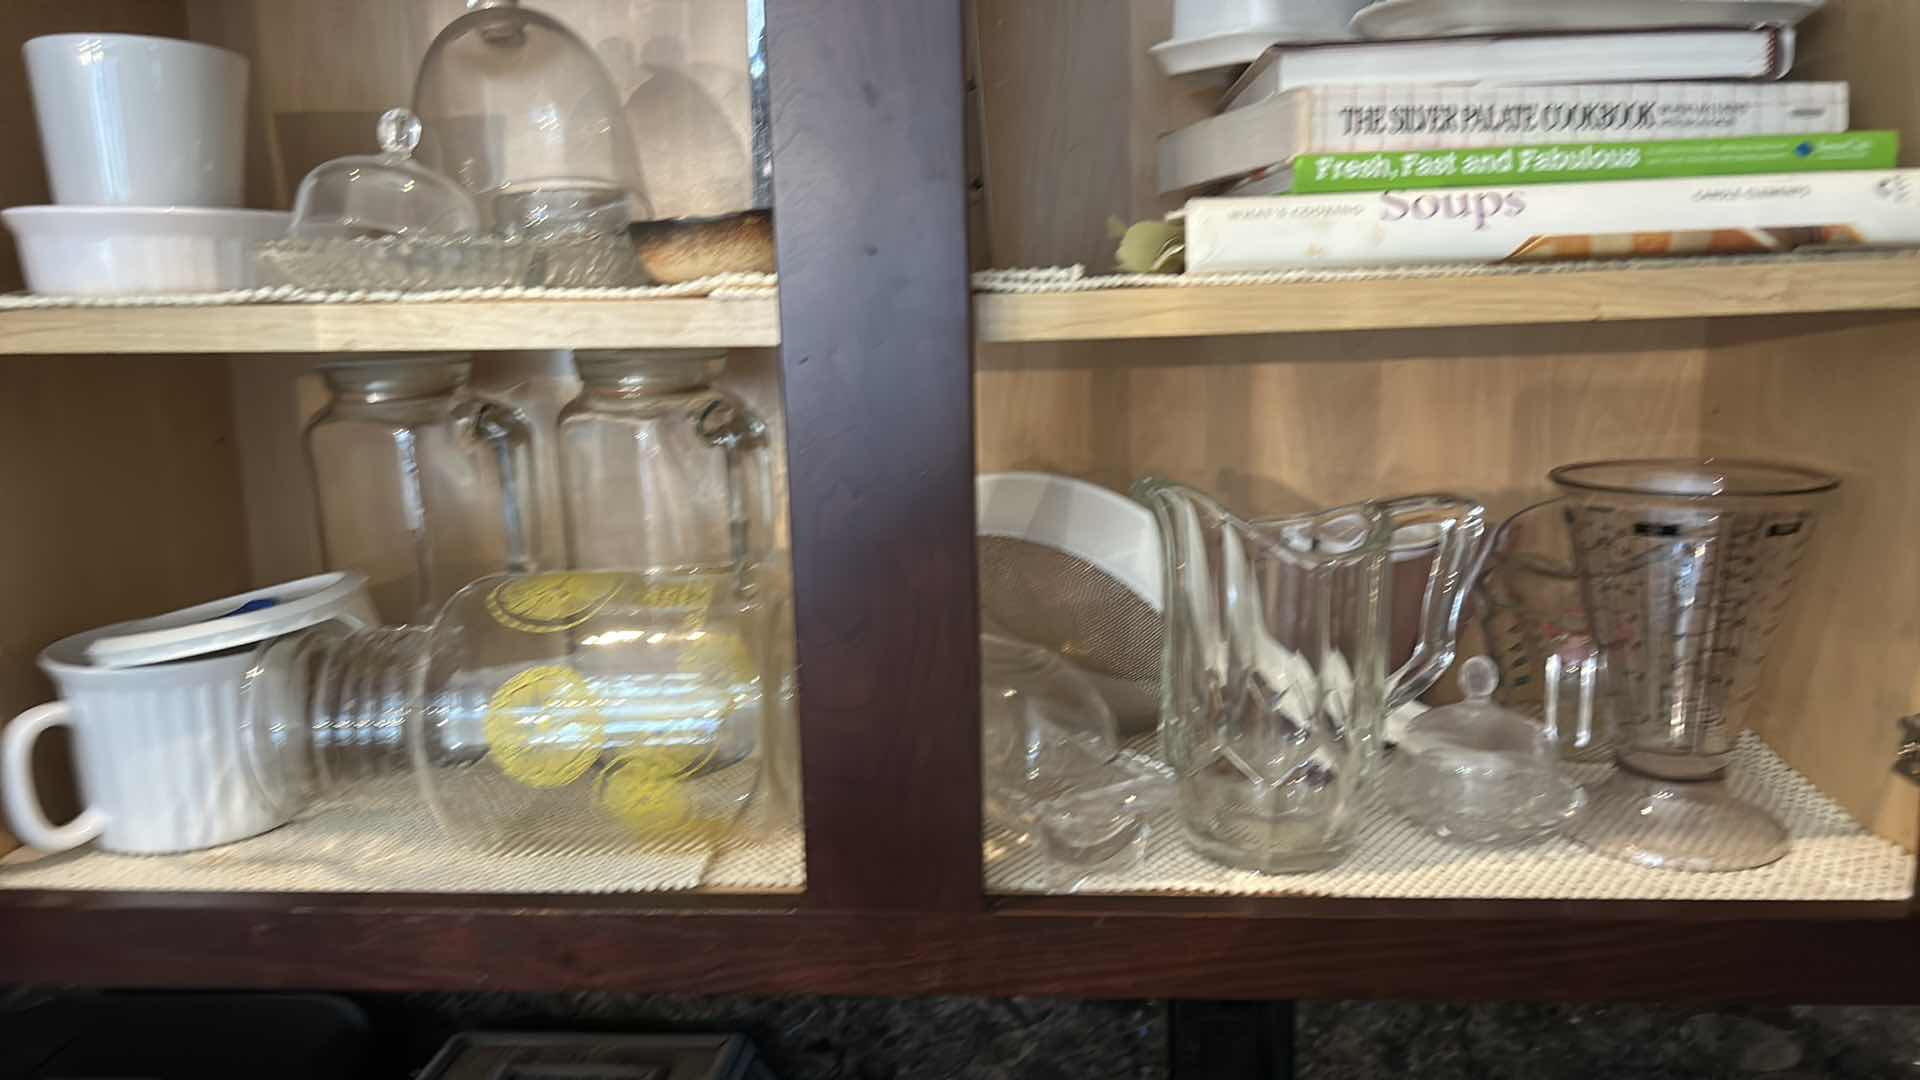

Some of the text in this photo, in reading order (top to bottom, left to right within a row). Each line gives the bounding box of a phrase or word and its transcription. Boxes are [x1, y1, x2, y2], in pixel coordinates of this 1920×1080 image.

[1341, 105, 1388, 135] THE
[1389, 104, 1458, 135] SILVER
[1460, 103, 1538, 134] PALATE
[1540, 101, 1657, 132] COOKBOOK
[1314, 154, 1398, 182] Fresh,
[1400, 152, 1458, 178] Fast
[1461, 150, 1513, 176] and
[1517, 147, 1642, 173] Fabulous
[1380, 190, 1527, 231] Soups
